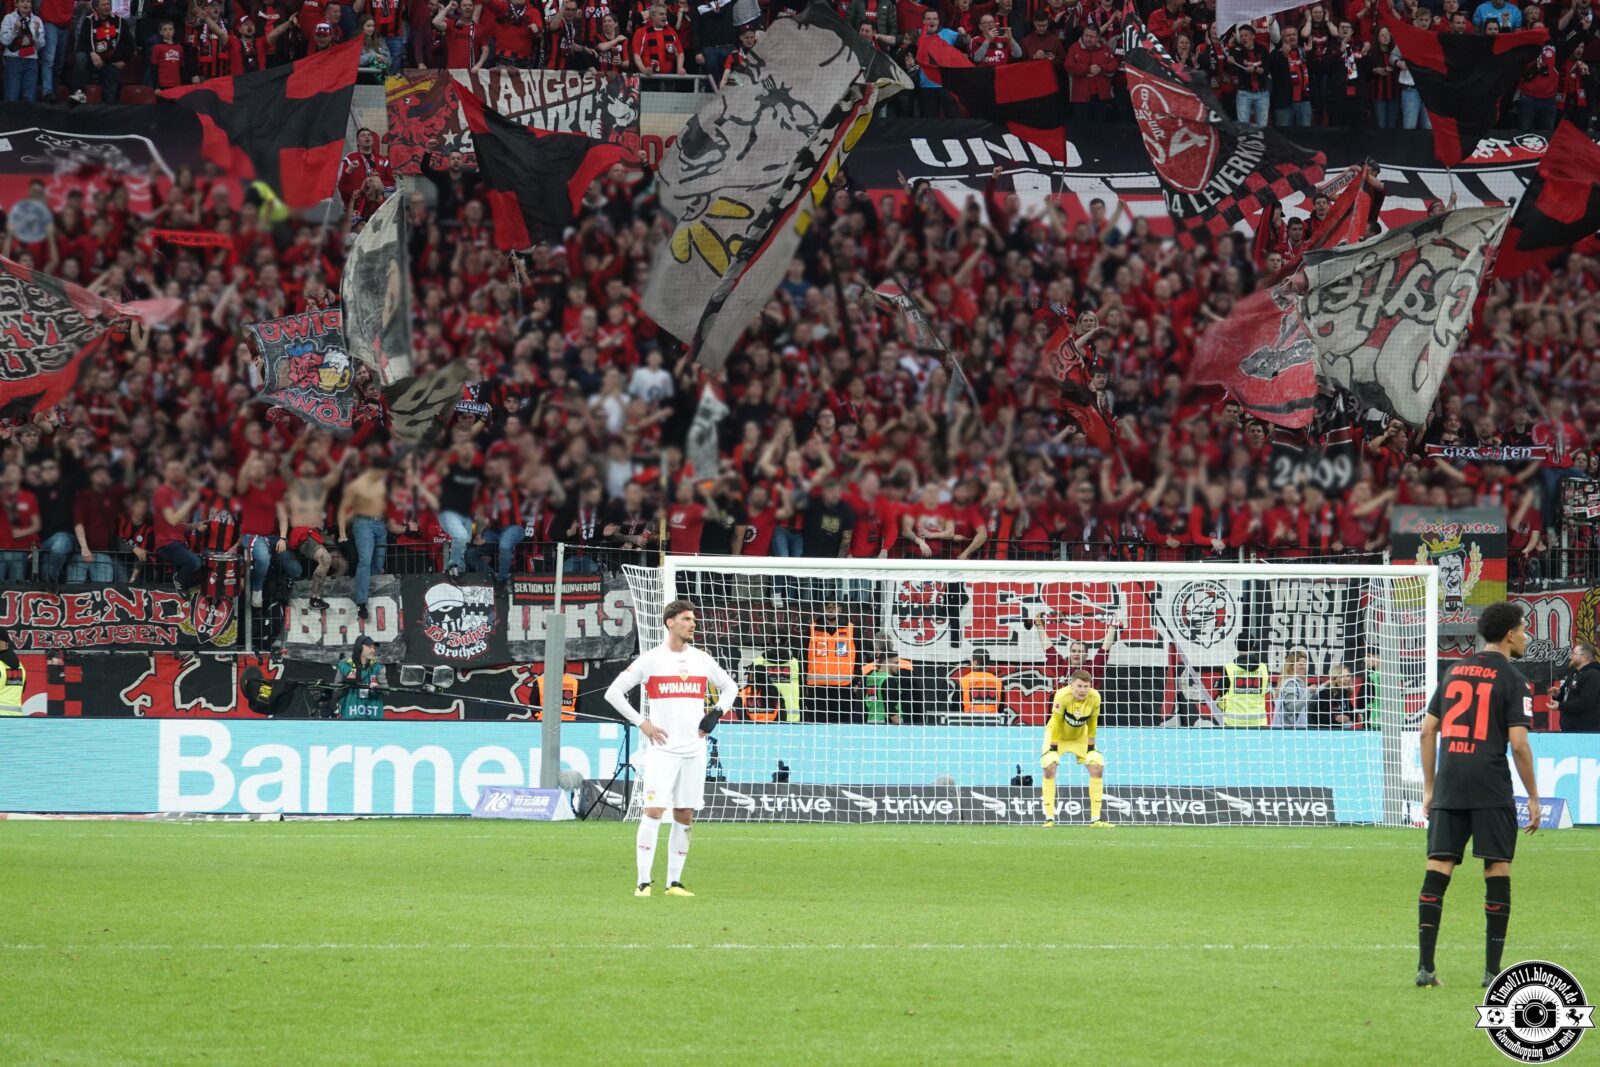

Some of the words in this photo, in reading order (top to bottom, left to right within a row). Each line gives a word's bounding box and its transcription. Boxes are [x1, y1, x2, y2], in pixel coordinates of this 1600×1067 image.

[1464, 521, 1500, 534] von
[514, 583, 543, 593] SEKTION
[1269, 581, 1346, 613] WEST
[1269, 614, 1345, 646] SIDE
[434, 640, 488, 660] Brothers
[1268, 646, 1344, 676] BYZ
[349, 705, 379, 718] HOST
[1441, 680, 1494, 741] 21
[1448, 741, 1475, 754] ADLI
[760, 794, 832, 813] trive
[883, 795, 954, 816] trive
[1136, 796, 1206, 816] trive
[1257, 797, 1328, 817] trive
